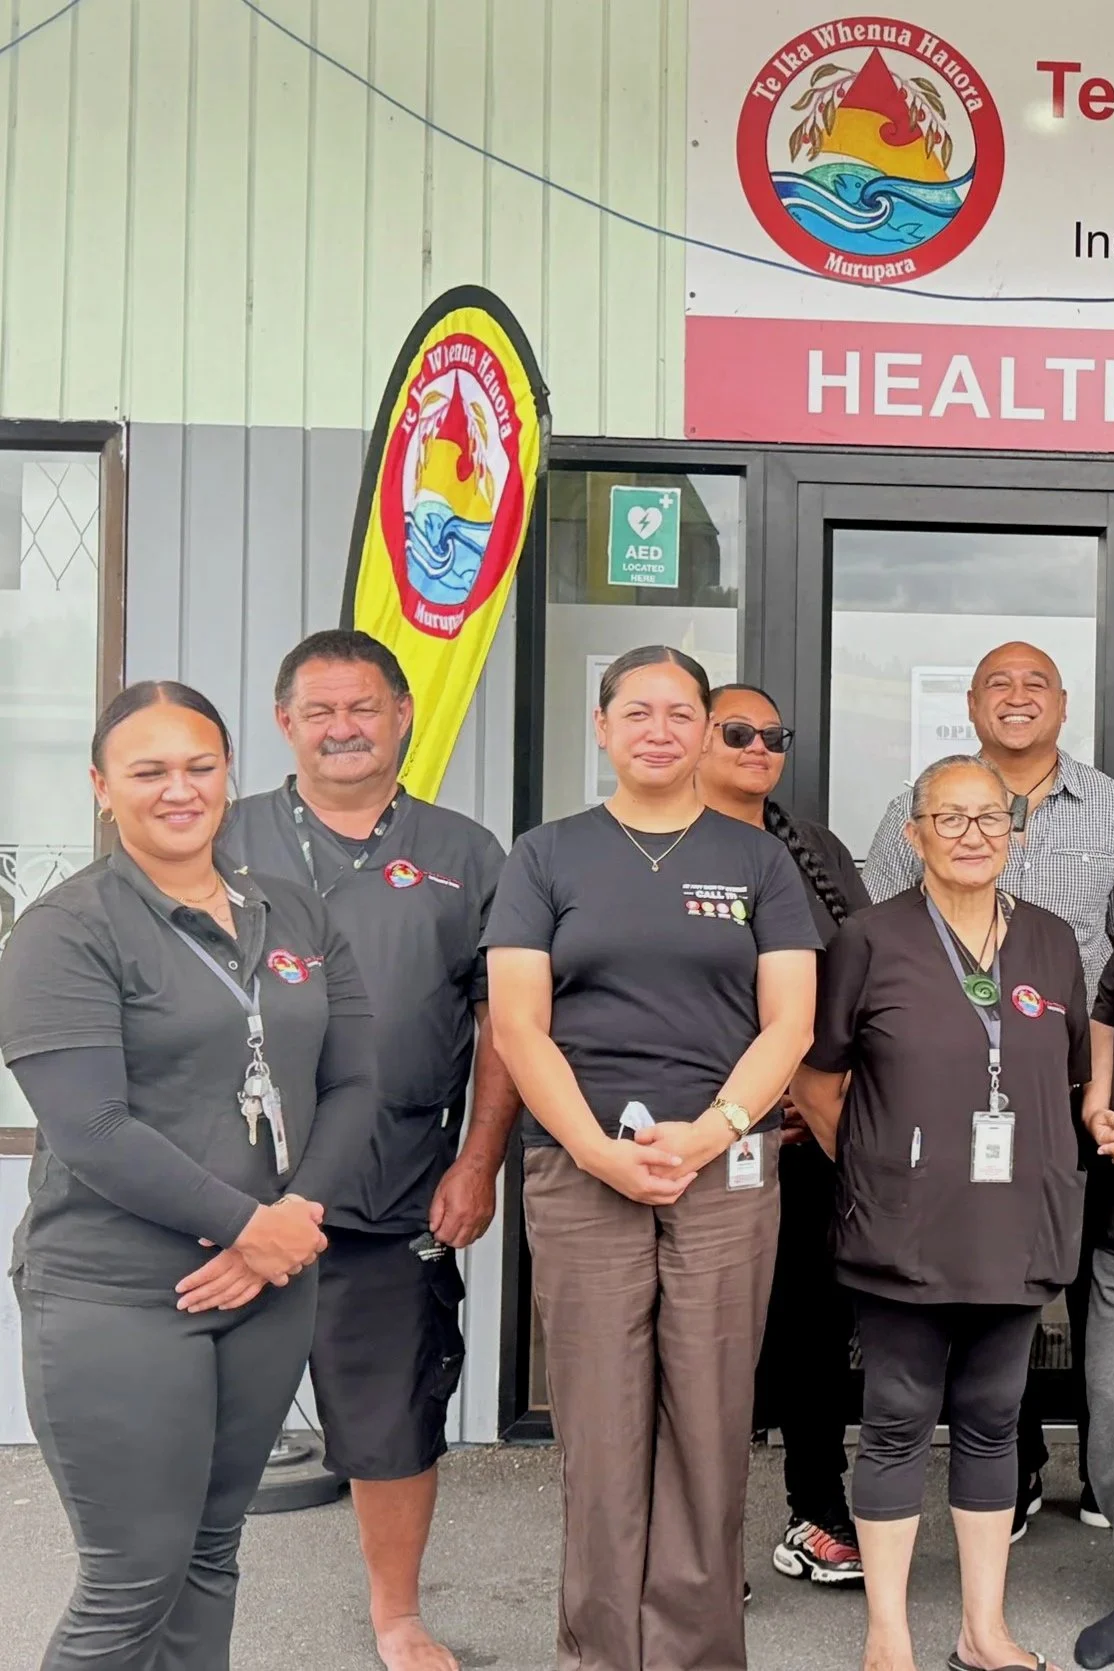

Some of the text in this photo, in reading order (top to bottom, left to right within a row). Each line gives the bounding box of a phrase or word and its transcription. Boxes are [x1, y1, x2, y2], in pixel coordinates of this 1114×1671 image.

[752, 21, 984, 114] Te Ika Whenua Hauora
[823, 252, 916, 282] Murupara
[477, 350, 513, 441] Hauora
[625, 545, 663, 560] AED
[622, 563, 665, 573] LOCATED
[630, 574, 656, 583] HERE
[695, 890, 725, 900] CALL
